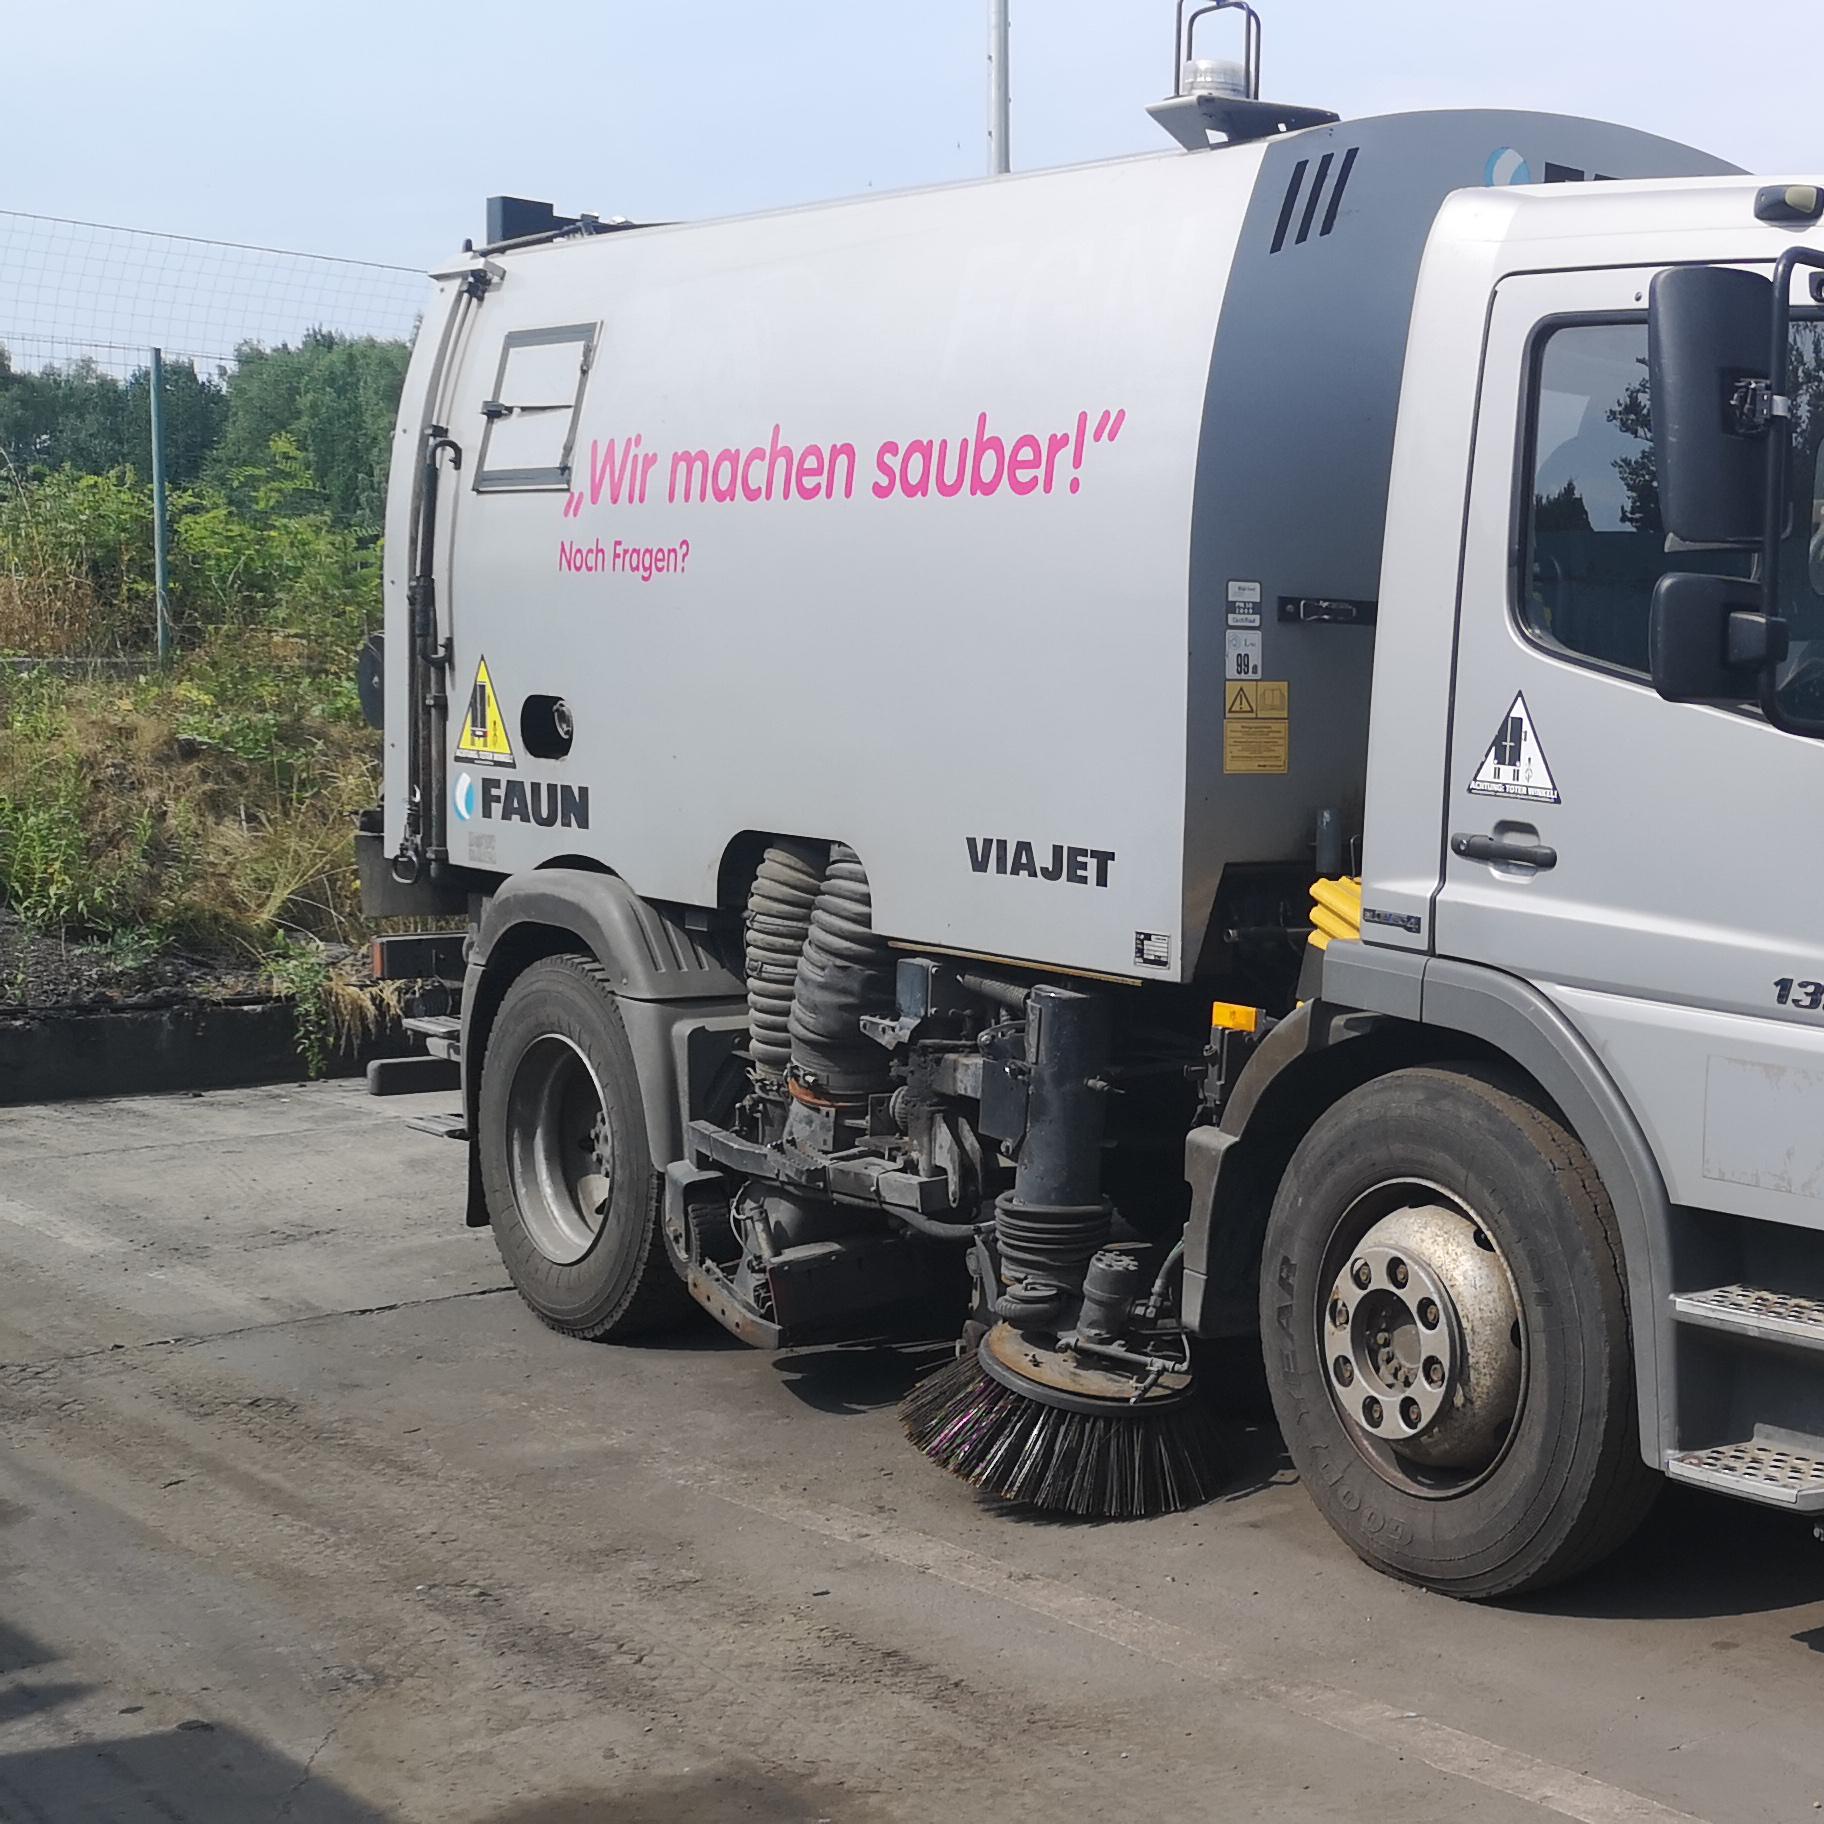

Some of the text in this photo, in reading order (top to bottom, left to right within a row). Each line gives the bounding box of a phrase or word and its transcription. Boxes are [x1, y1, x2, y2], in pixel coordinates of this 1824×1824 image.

[668, 423, 856, 503] machen
[559, 537, 690, 582] Noch Fragen?
[1236, 653, 1249, 674] 99
[481, 777, 589, 830] FAUN
[1505, 784, 1527, 794] TOTER
[966, 836, 1115, 888] VIAJET
